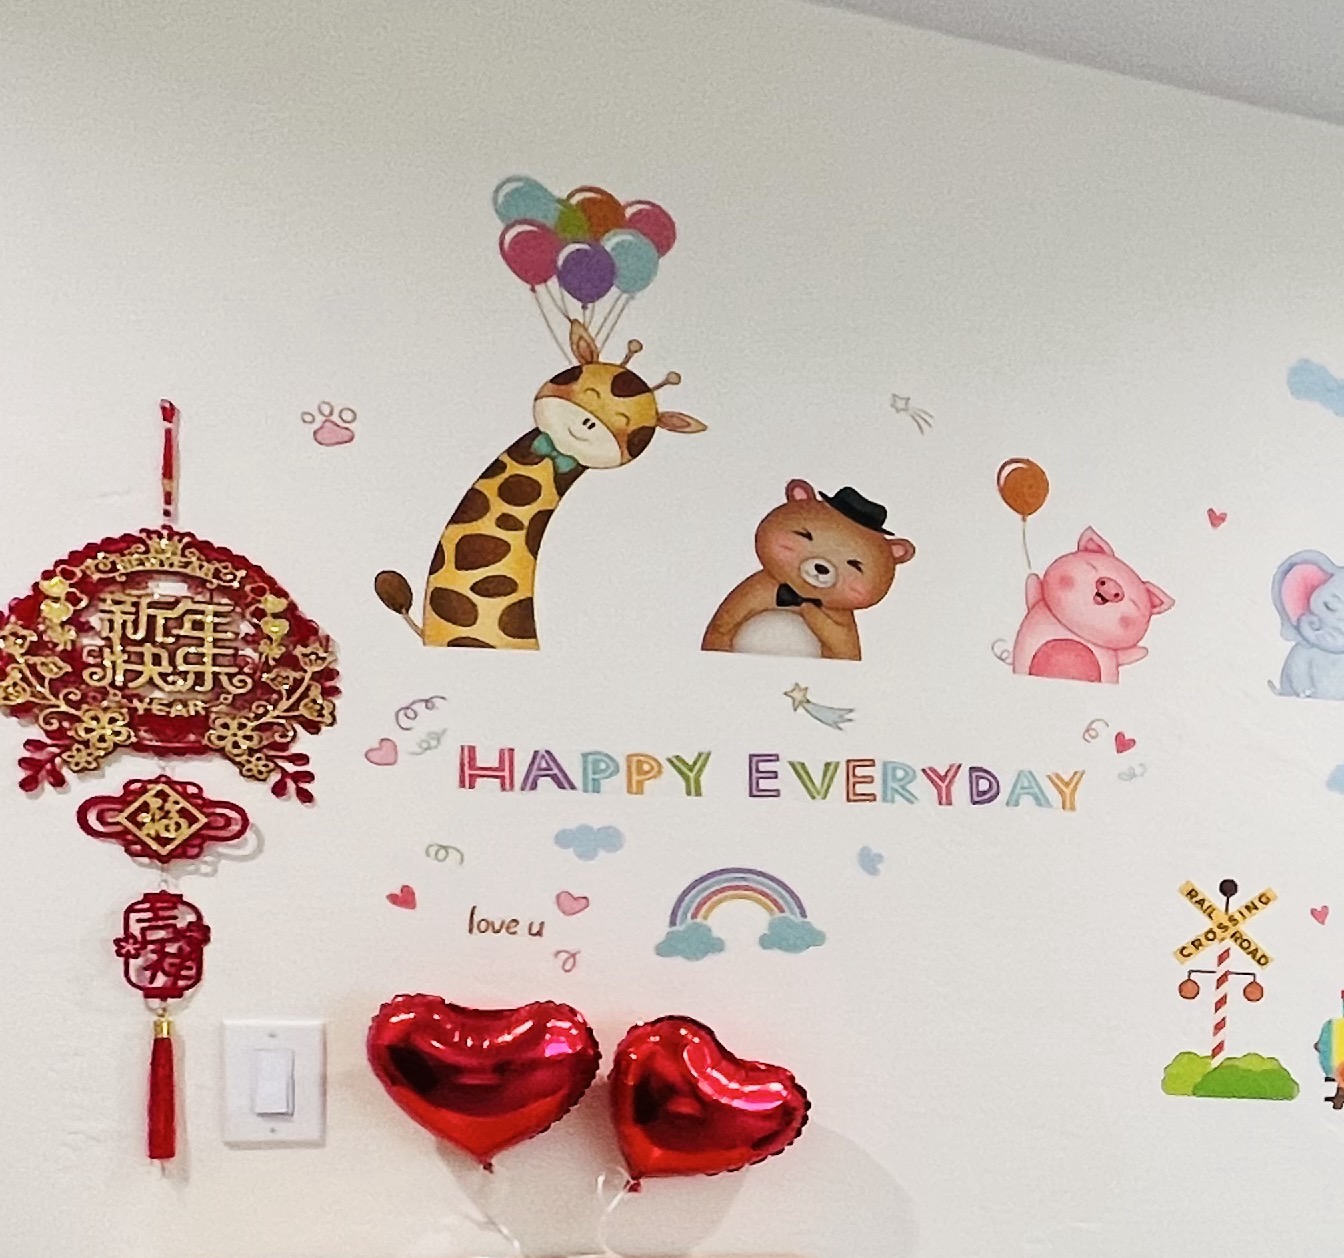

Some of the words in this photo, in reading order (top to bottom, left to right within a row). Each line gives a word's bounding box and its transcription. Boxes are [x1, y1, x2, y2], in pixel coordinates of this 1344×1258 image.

[458, 744, 712, 798] HAPPY
[748, 752, 1086, 813] EVERYDAY
[468, 905, 520, 935] love
[528, 920, 546, 938] u
[1179, 892, 1273, 958] CROSSING
[1186, 888, 1216, 921] RAIL
[1230, 930, 1270, 967] ROAD
